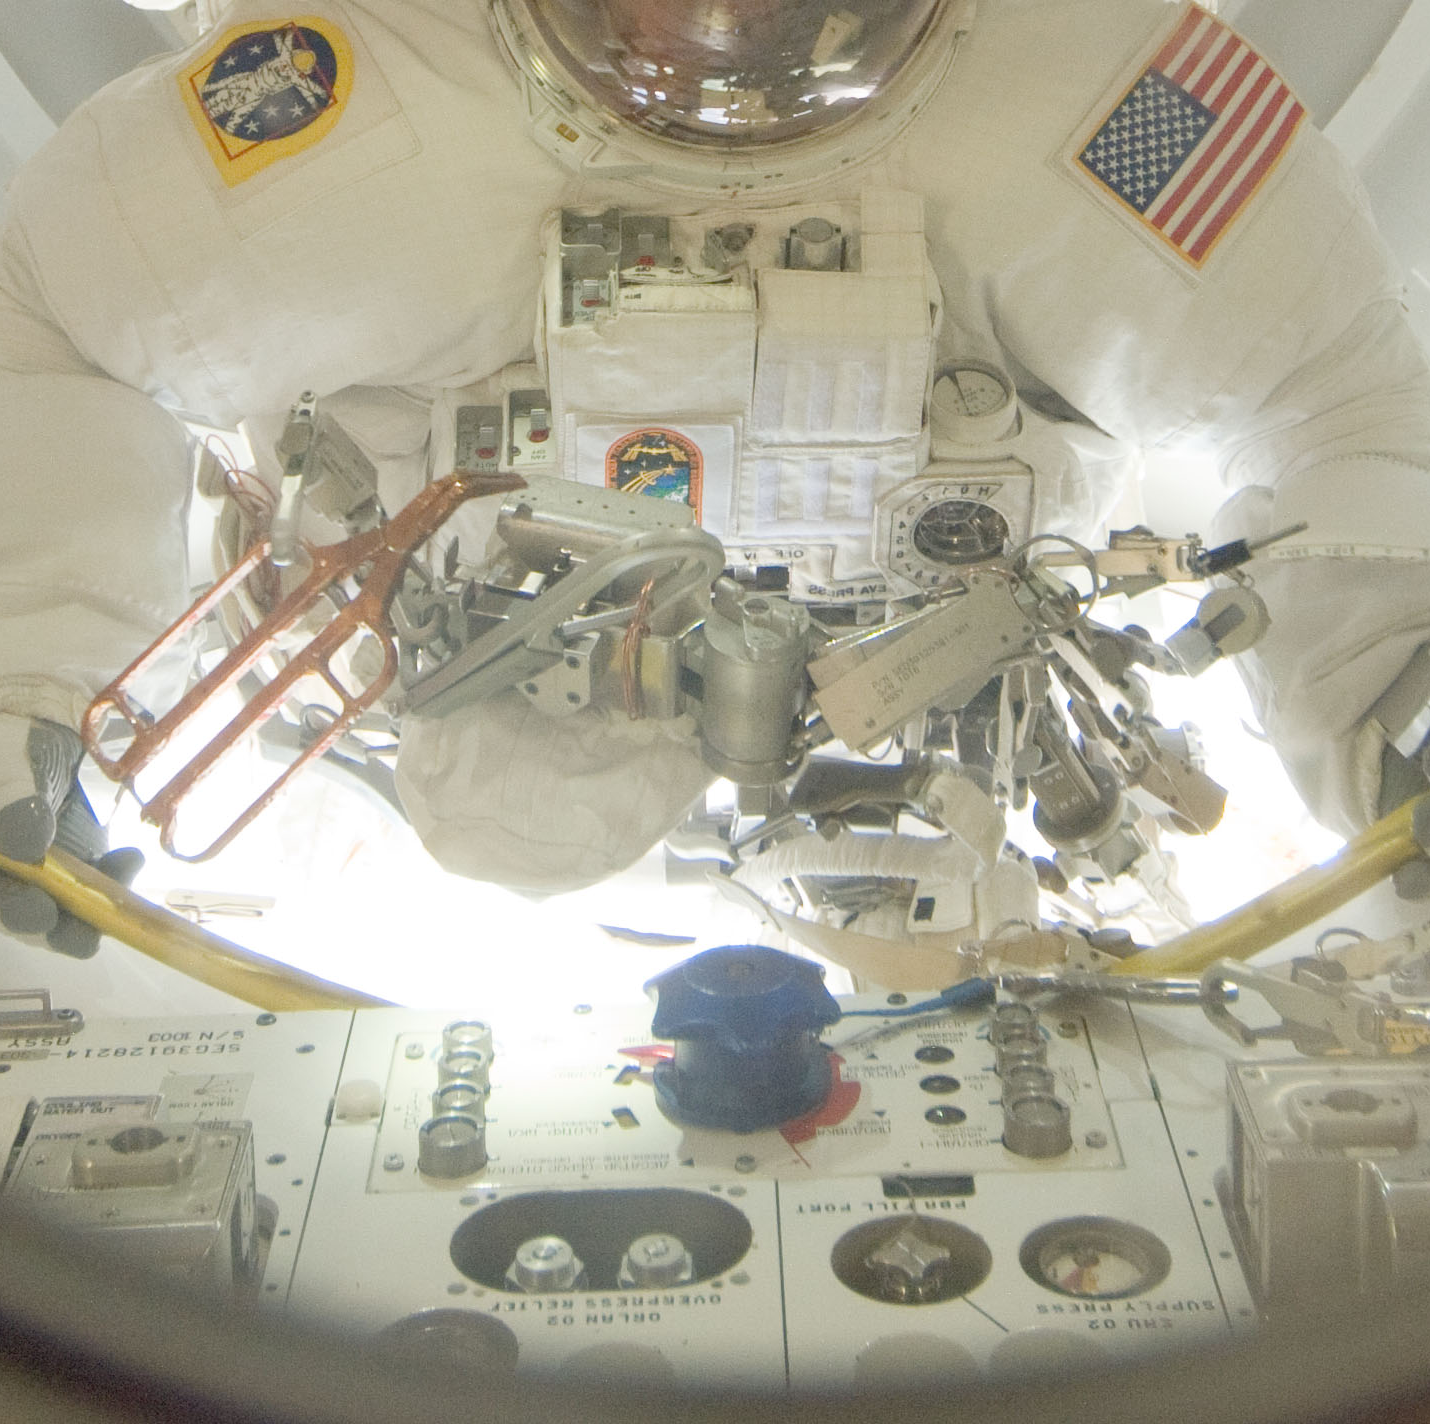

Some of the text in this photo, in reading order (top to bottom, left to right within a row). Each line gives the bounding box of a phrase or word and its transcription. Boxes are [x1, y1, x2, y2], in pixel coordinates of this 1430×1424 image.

[148, 1030, 245, 1044] S/N 1003
[796, 1202, 851, 1216] PORT
[487, 1293, 722, 1313] OVERPRESS RELIEF
[1034, 1300, 1216, 1315] SUPPLY PRESS
[585, 1311, 662, 1325] ORLAN
